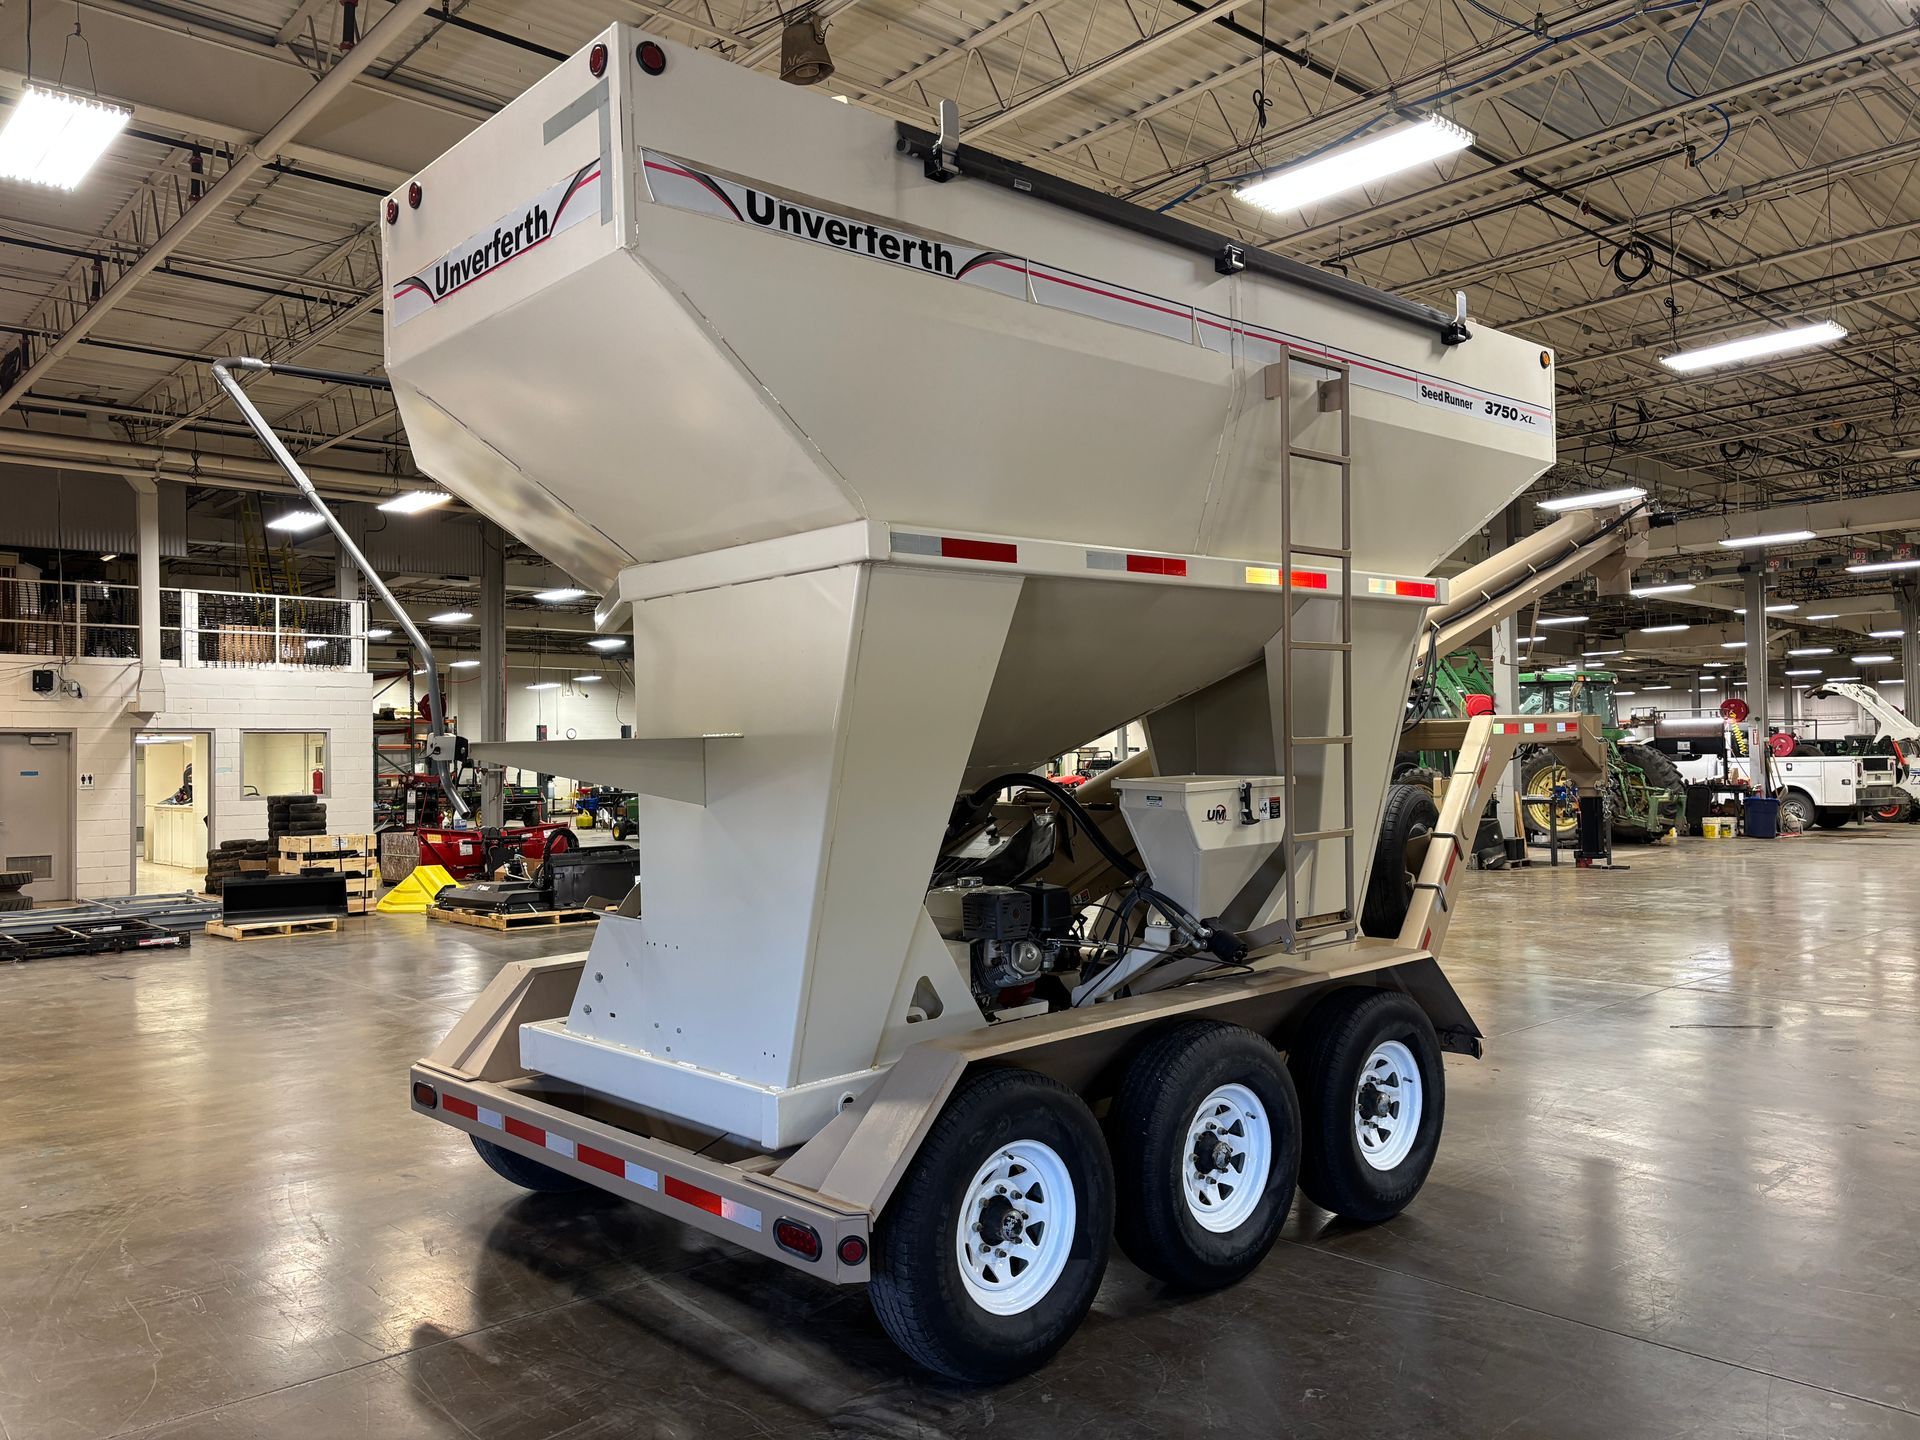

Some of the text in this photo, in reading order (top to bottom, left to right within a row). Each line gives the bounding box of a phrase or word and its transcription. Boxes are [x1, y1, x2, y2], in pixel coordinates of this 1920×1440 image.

[746, 188, 953, 276] Unverferth
[435, 204, 549, 296] Unverferth
[1484, 401, 1536, 425] 3750 XL
[1769, 560, 1780, 569] 99
[1852, 551, 1866, 560] 103
[1206, 809, 1226, 821] UM
